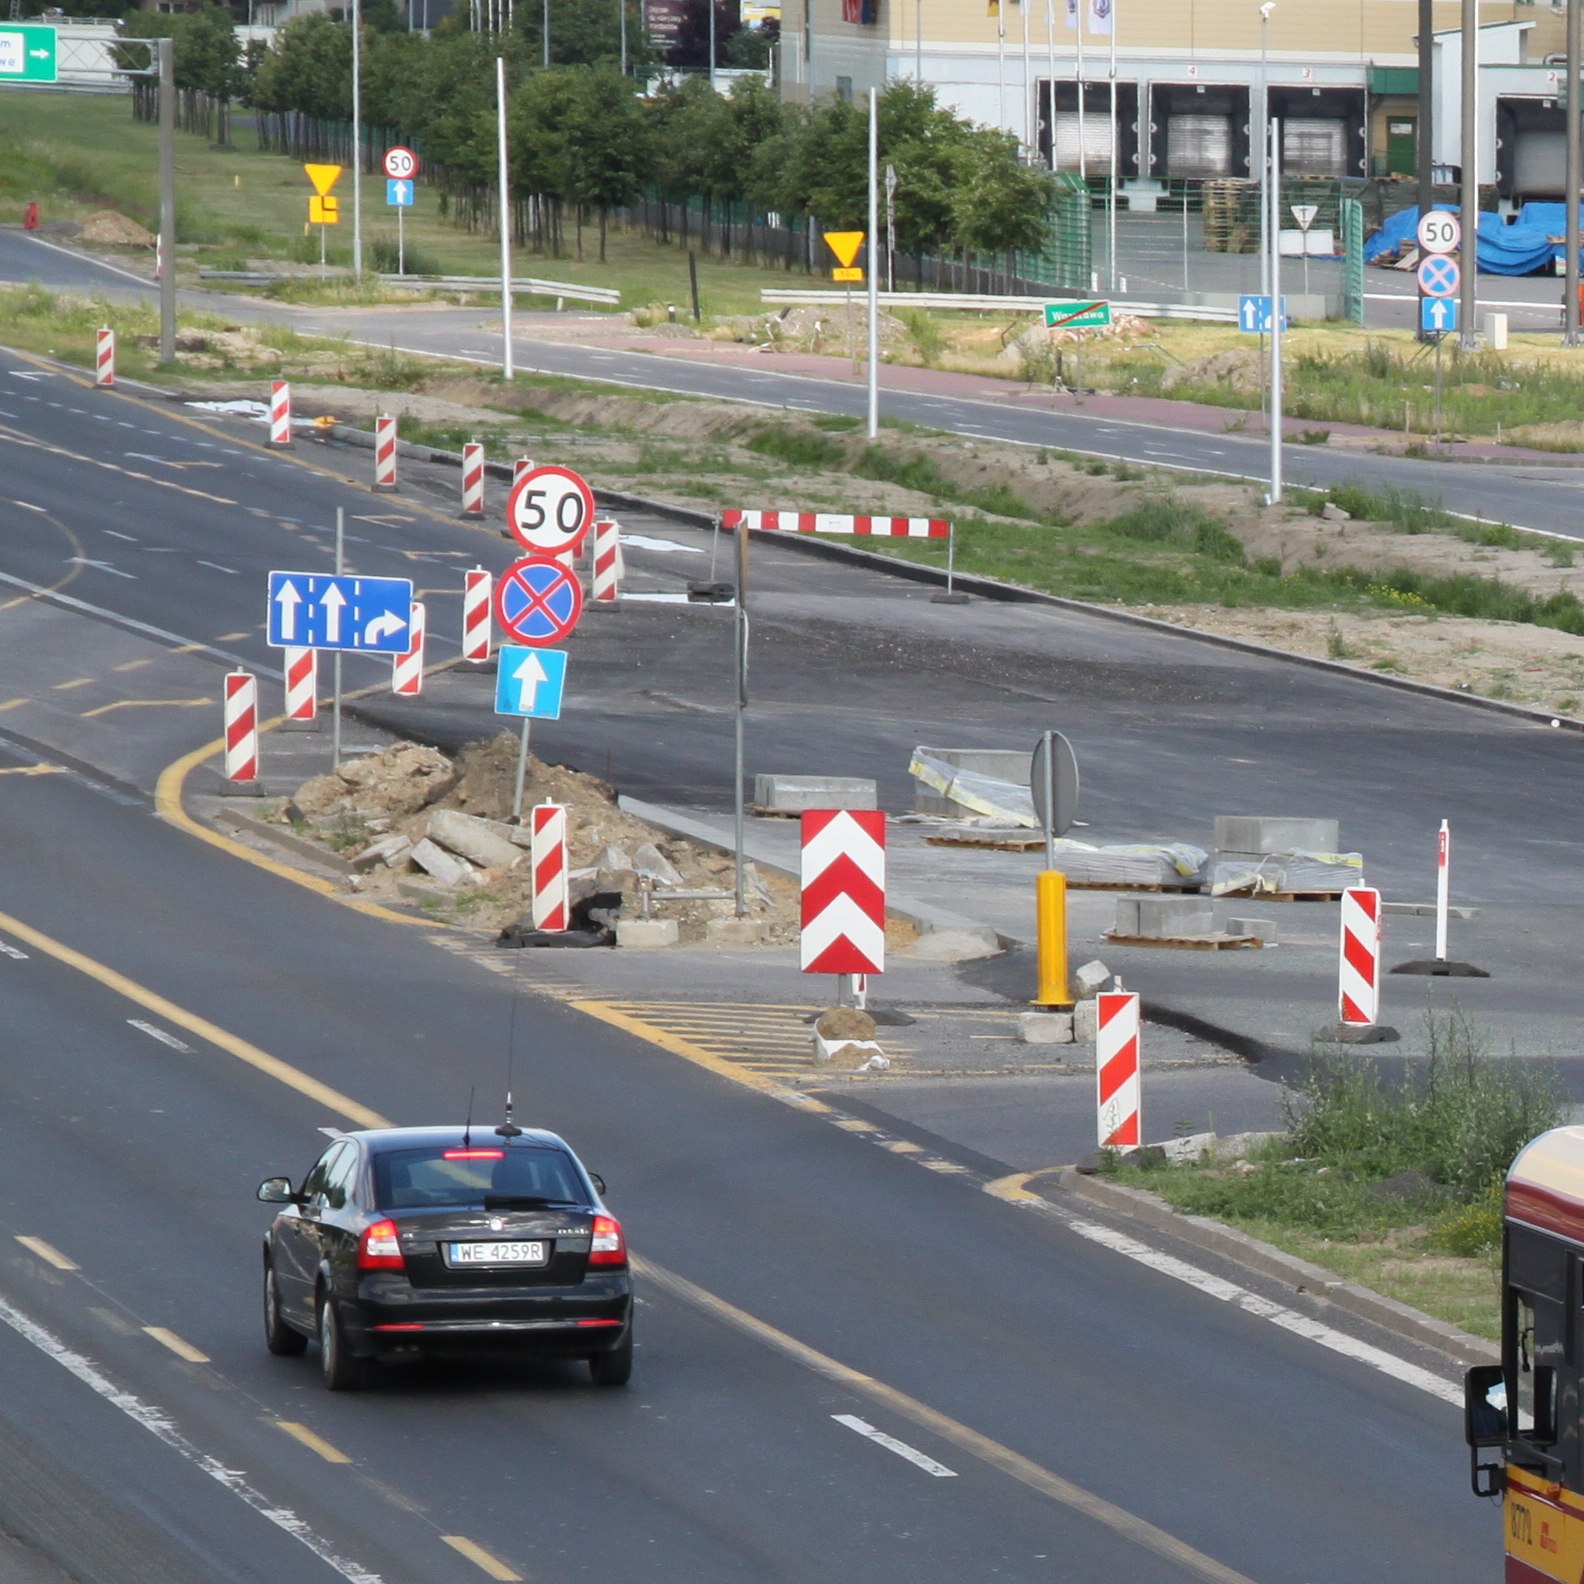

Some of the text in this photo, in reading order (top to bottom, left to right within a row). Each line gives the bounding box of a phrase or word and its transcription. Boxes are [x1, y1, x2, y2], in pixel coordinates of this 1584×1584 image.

[390, 155, 412, 171] 50
[1425, 222, 1454, 242] 50
[521, 490, 584, 533] 50
[461, 1243, 541, 1261] WE 4259R
